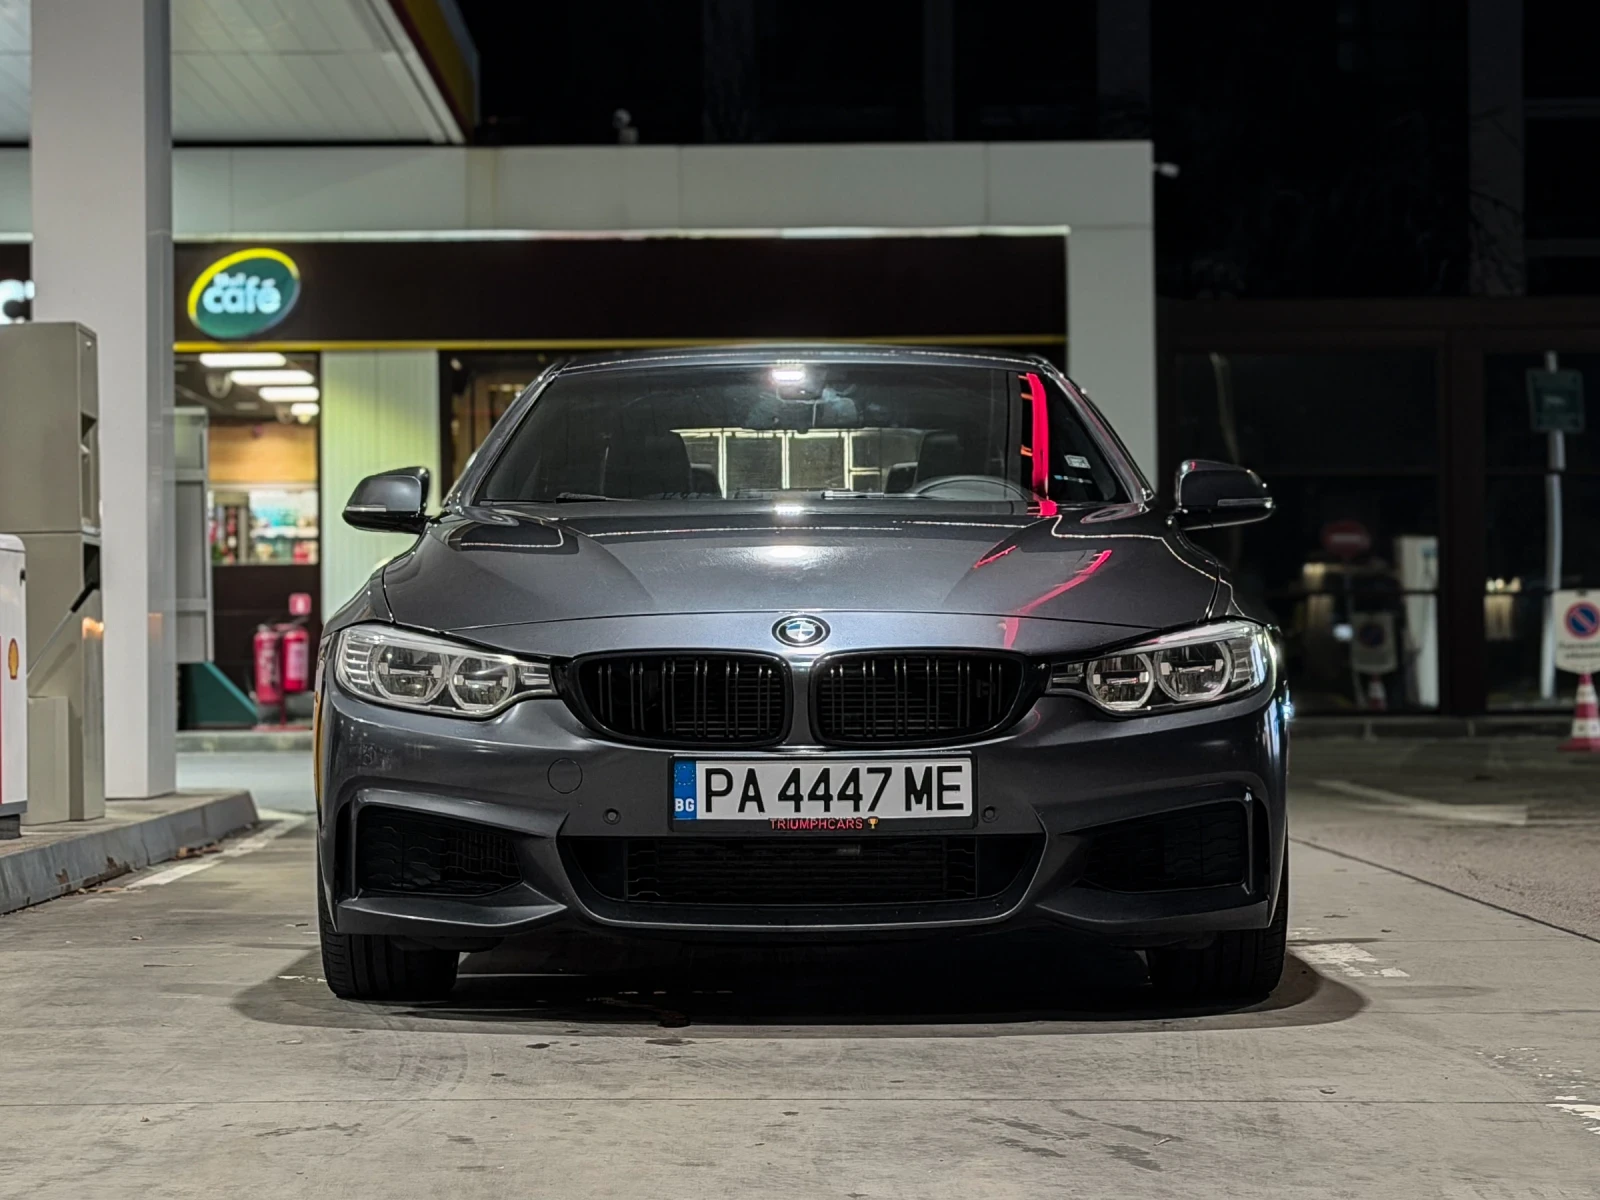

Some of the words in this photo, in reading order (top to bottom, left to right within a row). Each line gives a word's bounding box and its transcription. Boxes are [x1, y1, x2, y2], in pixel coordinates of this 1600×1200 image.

[705, 767, 766, 813] PA
[777, 767, 893, 813] 4447
[904, 765, 964, 812] ME
[674, 798, 695, 812] BG
